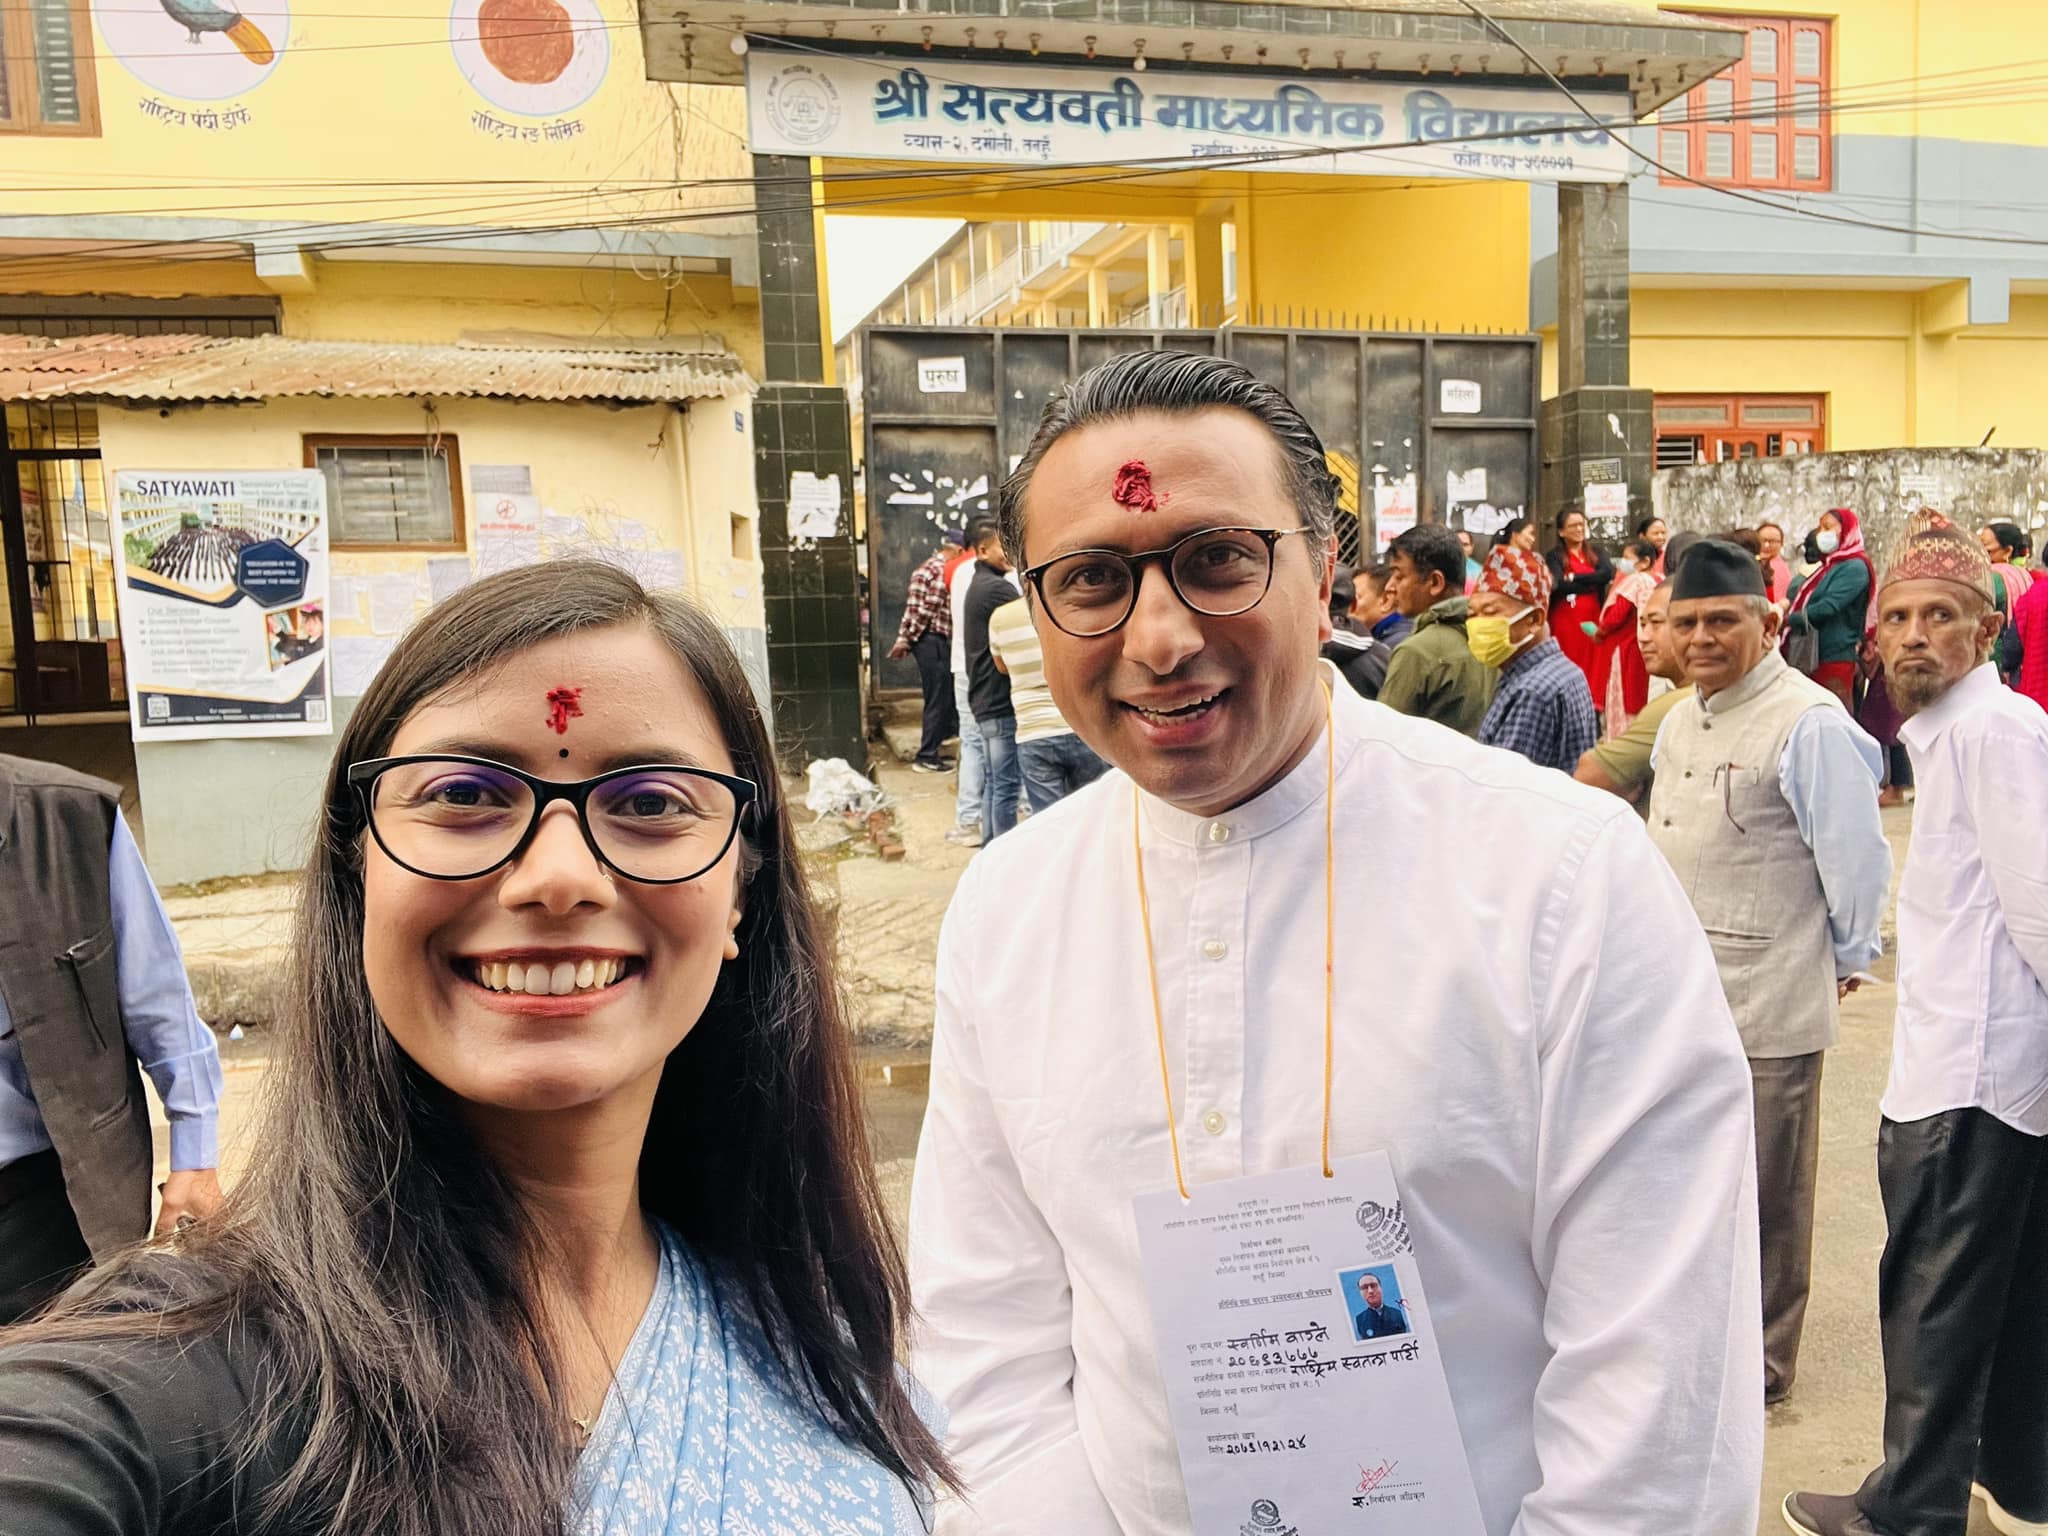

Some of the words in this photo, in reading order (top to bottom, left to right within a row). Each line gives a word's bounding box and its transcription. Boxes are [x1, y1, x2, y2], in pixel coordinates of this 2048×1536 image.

[874, 67, 930, 118] श्री
[943, 76, 1142, 134] सत्यवती
[1153, 84, 1385, 137] माध्यमिक
[1404, 89, 1615, 145] विद्यालय
[924, 368, 960, 388] पुरुष
[136, 479, 235, 497] SATYAWATI
